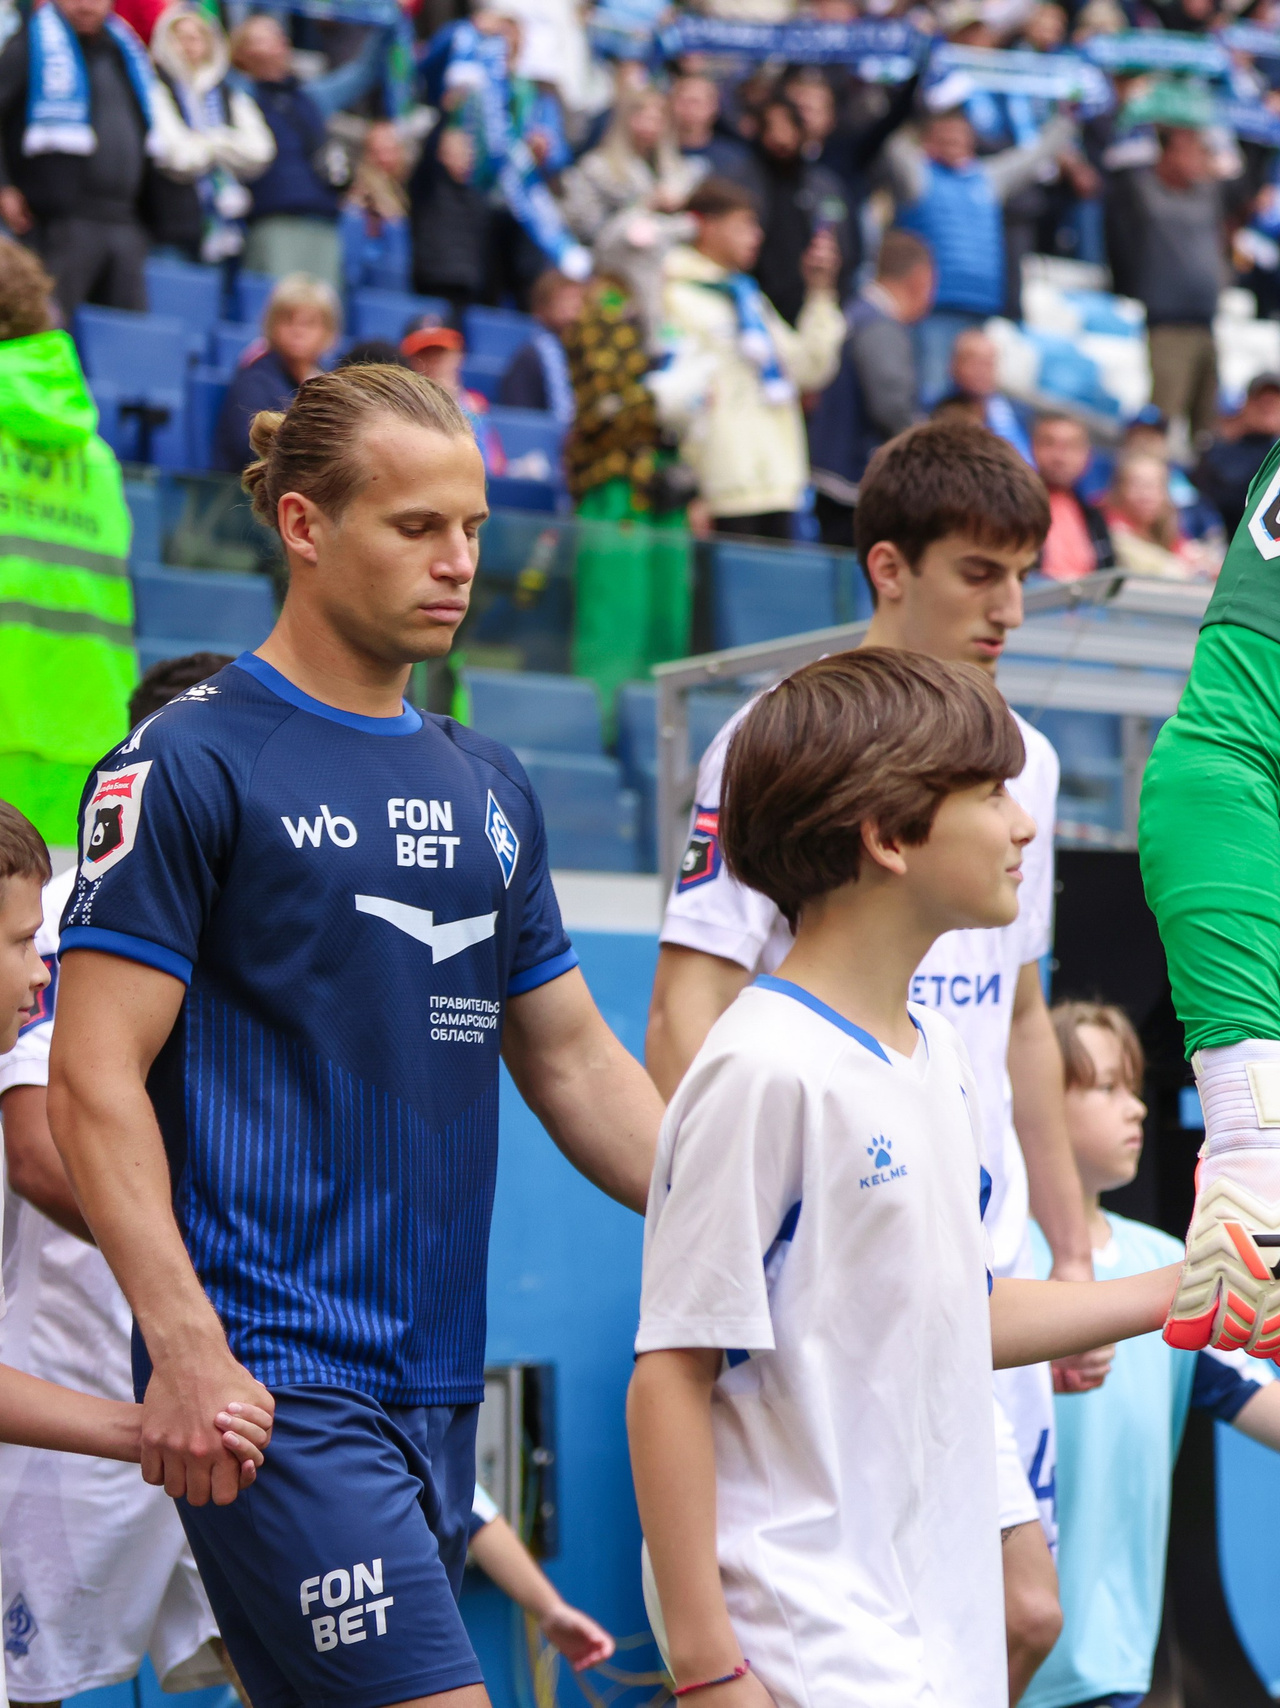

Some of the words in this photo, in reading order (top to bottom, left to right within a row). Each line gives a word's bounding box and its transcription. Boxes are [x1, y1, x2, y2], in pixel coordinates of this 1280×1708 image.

[280, 804, 358, 849] wb
[387, 798, 453, 831] FON
[396, 834, 461, 869] BET
[429, 995, 500, 1014] ПРАВИТЕЛЬС
[429, 1011, 498, 1030] САМАРСКОЙ
[430, 1027, 485, 1045] ОБЛАСТИ
[859, 1164, 909, 1190] KELME
[300, 1557, 384, 1616] FON
[311, 1595, 394, 1653] BET
